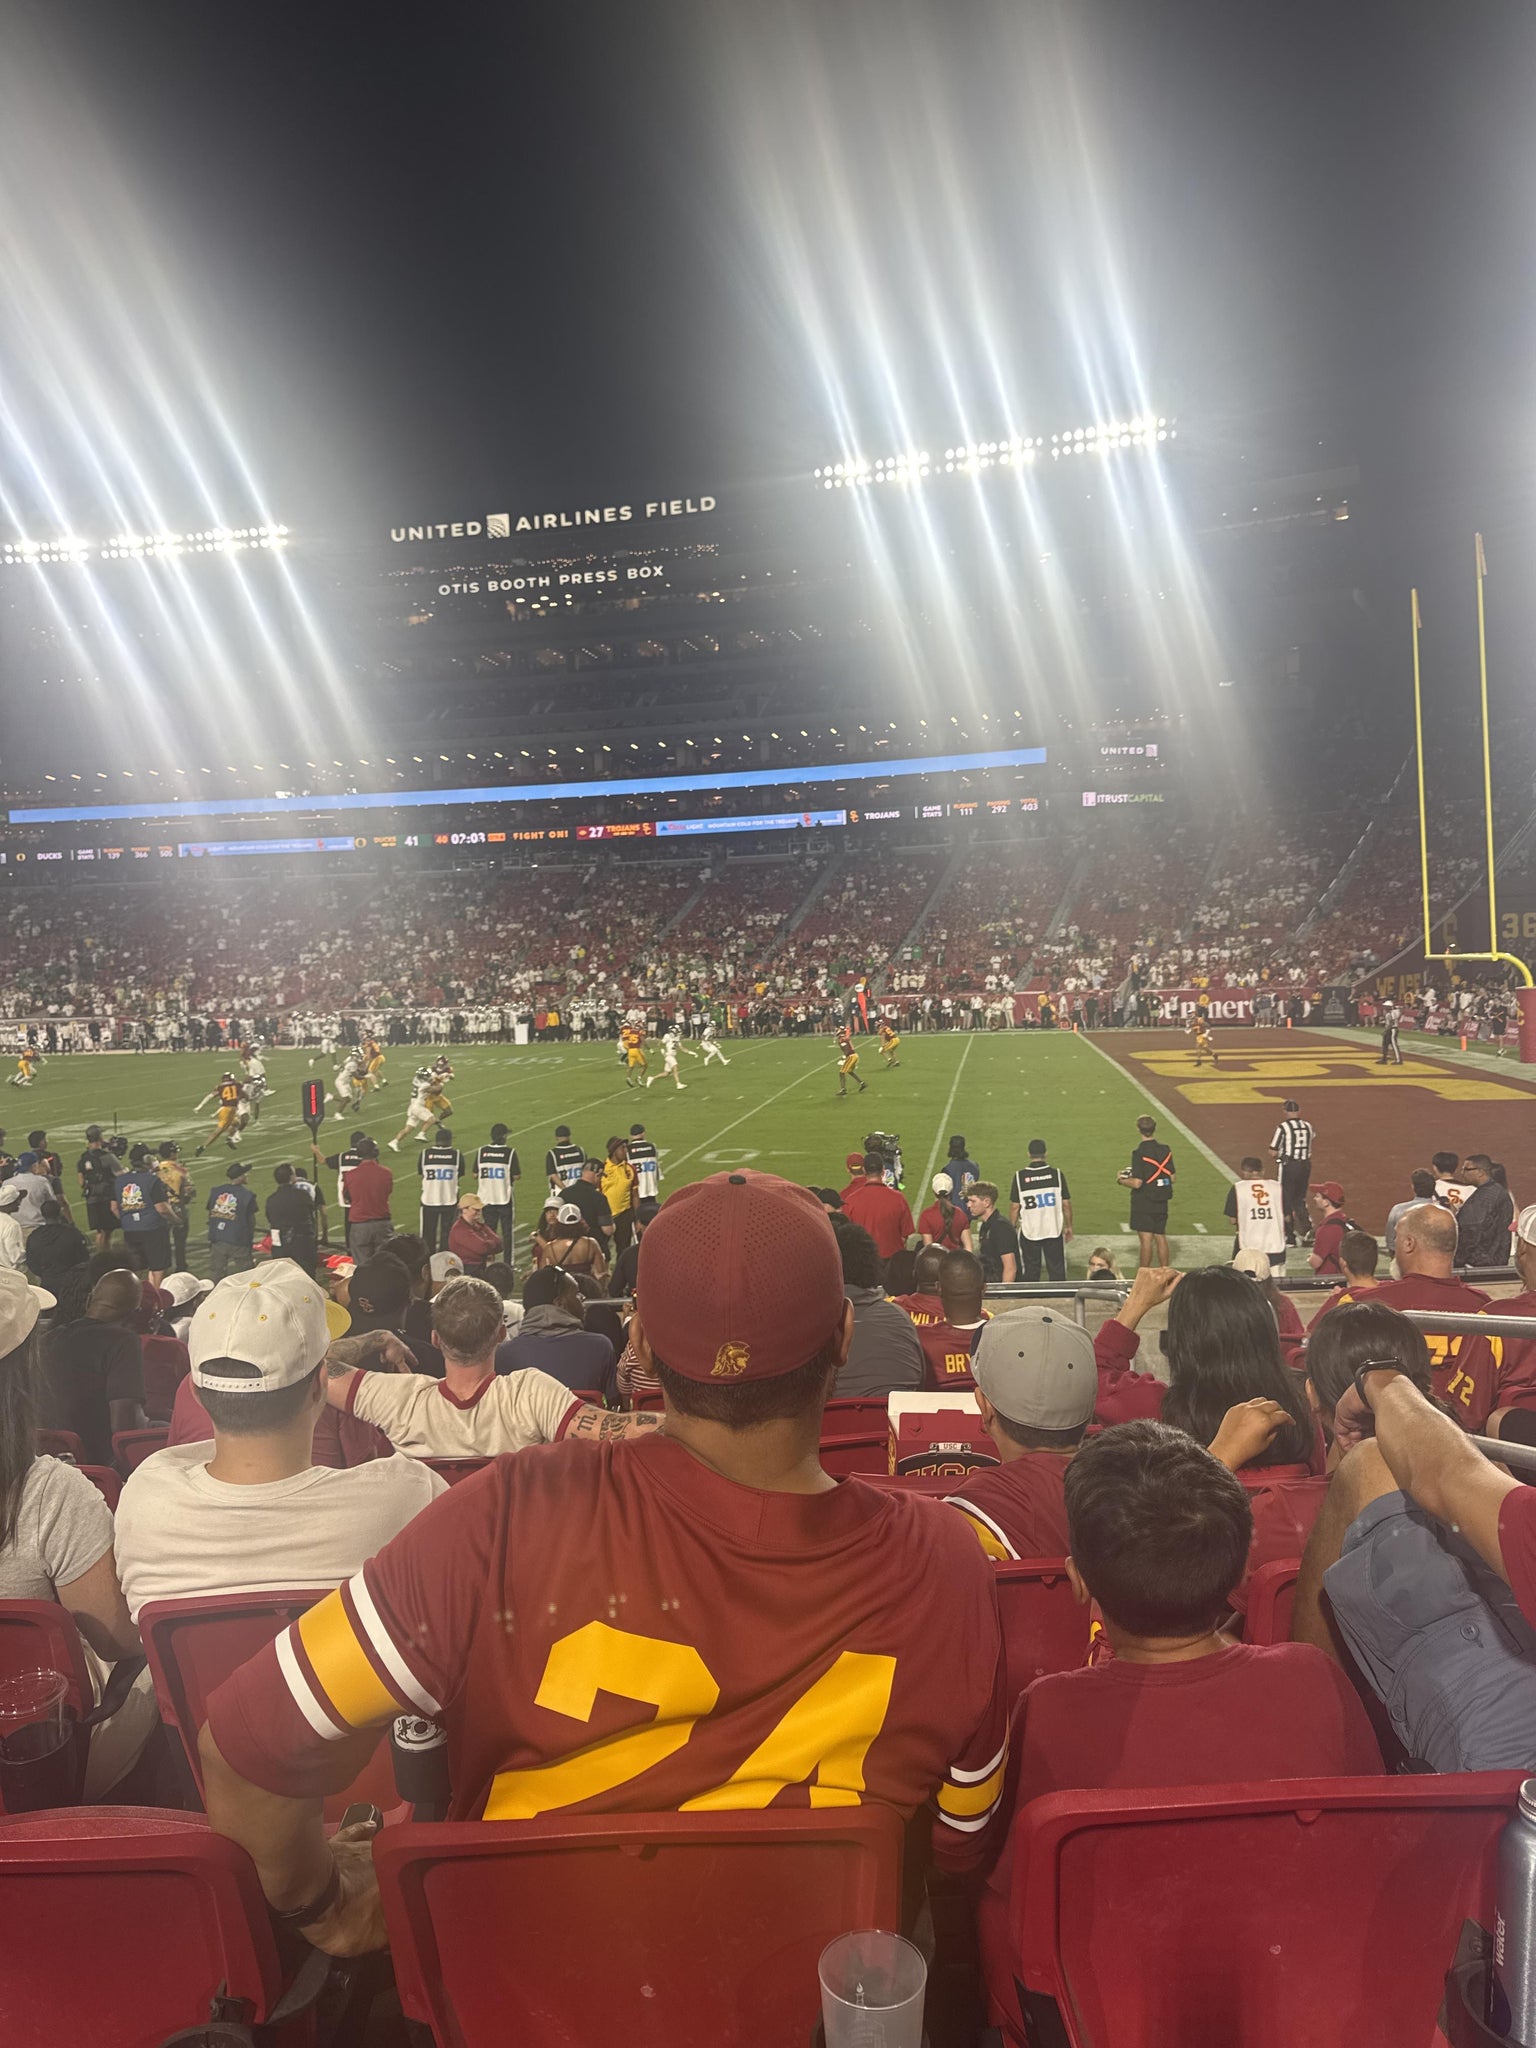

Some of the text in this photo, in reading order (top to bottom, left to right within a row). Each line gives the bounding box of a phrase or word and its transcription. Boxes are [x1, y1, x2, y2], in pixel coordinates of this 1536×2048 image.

[390, 496, 717, 543] UNITED AIRLINES FIELD
[438, 565, 664, 596] OTIS BOOTH PRESS BOX
[1100, 746, 1144, 755] UNITED
[960, 807, 973, 816] 111
[1021, 803, 1038, 811] 403
[864, 810, 900, 820] TROJANS
[513, 831, 545, 840] FIGHT
[548, 829, 568, 839] ON!
[588, 826, 604, 838] 27
[404, 835, 419, 846] 41
[451, 831, 486, 845] 07:03
[37, 851, 63, 860] DUCKS
[222, 1084, 238, 1101] 41
[1294, 1129, 1309, 1148] H
[1251, 1183, 1269, 1206] SC
[122, 1196, 144, 1205] NBC
[214, 1204, 236, 1215] NBC
[1250, 1207, 1273, 1220] 191
[945, 1353, 973, 1373] BR
[943, 1442, 959, 1450] USC
